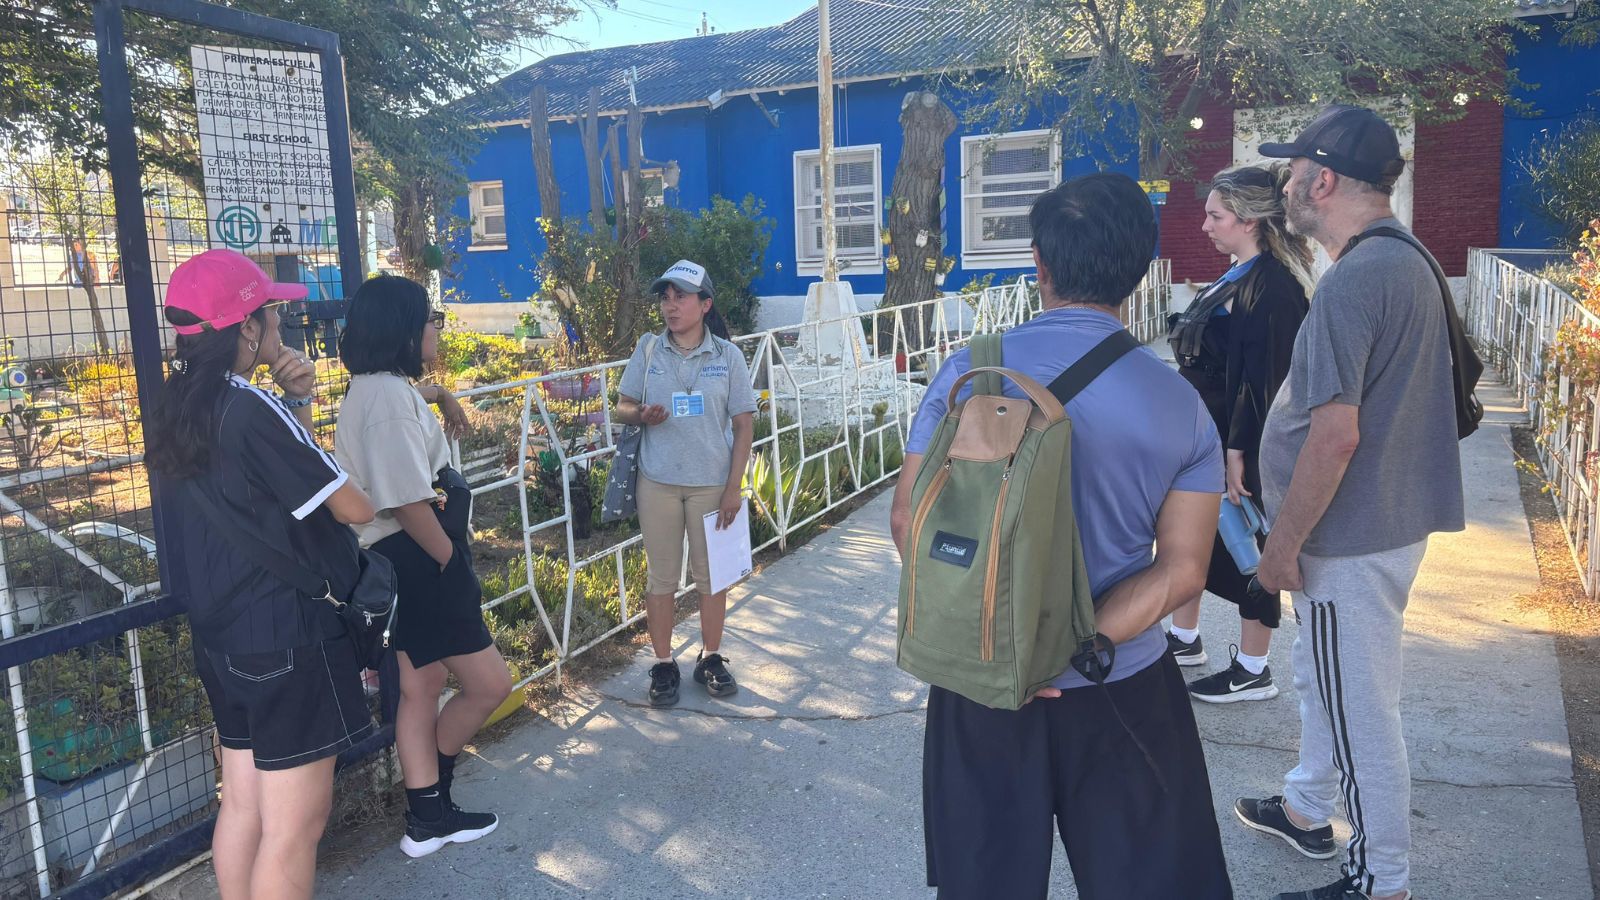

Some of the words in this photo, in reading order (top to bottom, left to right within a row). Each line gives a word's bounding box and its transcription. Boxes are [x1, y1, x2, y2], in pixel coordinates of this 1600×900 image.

[224, 54, 270, 65] PRIMERA
[272, 59, 316, 69] ESCUELA
[198, 70, 220, 80] ESTA
[196, 80, 229, 90] CALETA
[202, 98, 234, 108] PRIMER
[236, 101, 277, 110] DIRECTOR
[243, 133, 270, 142] FIRST
[272, 134, 313, 144] SCHOOL
[266, 152, 288, 160] FIRST
[207, 159, 241, 167] CALETA
[208, 167, 217, 175] IT
[219, 168, 237, 176] WAS
[239, 169, 277, 177] CREATED
[206, 185, 258, 195] FERNÁNDEZ
[260, 187, 280, 195] AND
[295, 187, 317, 195] FIRST
